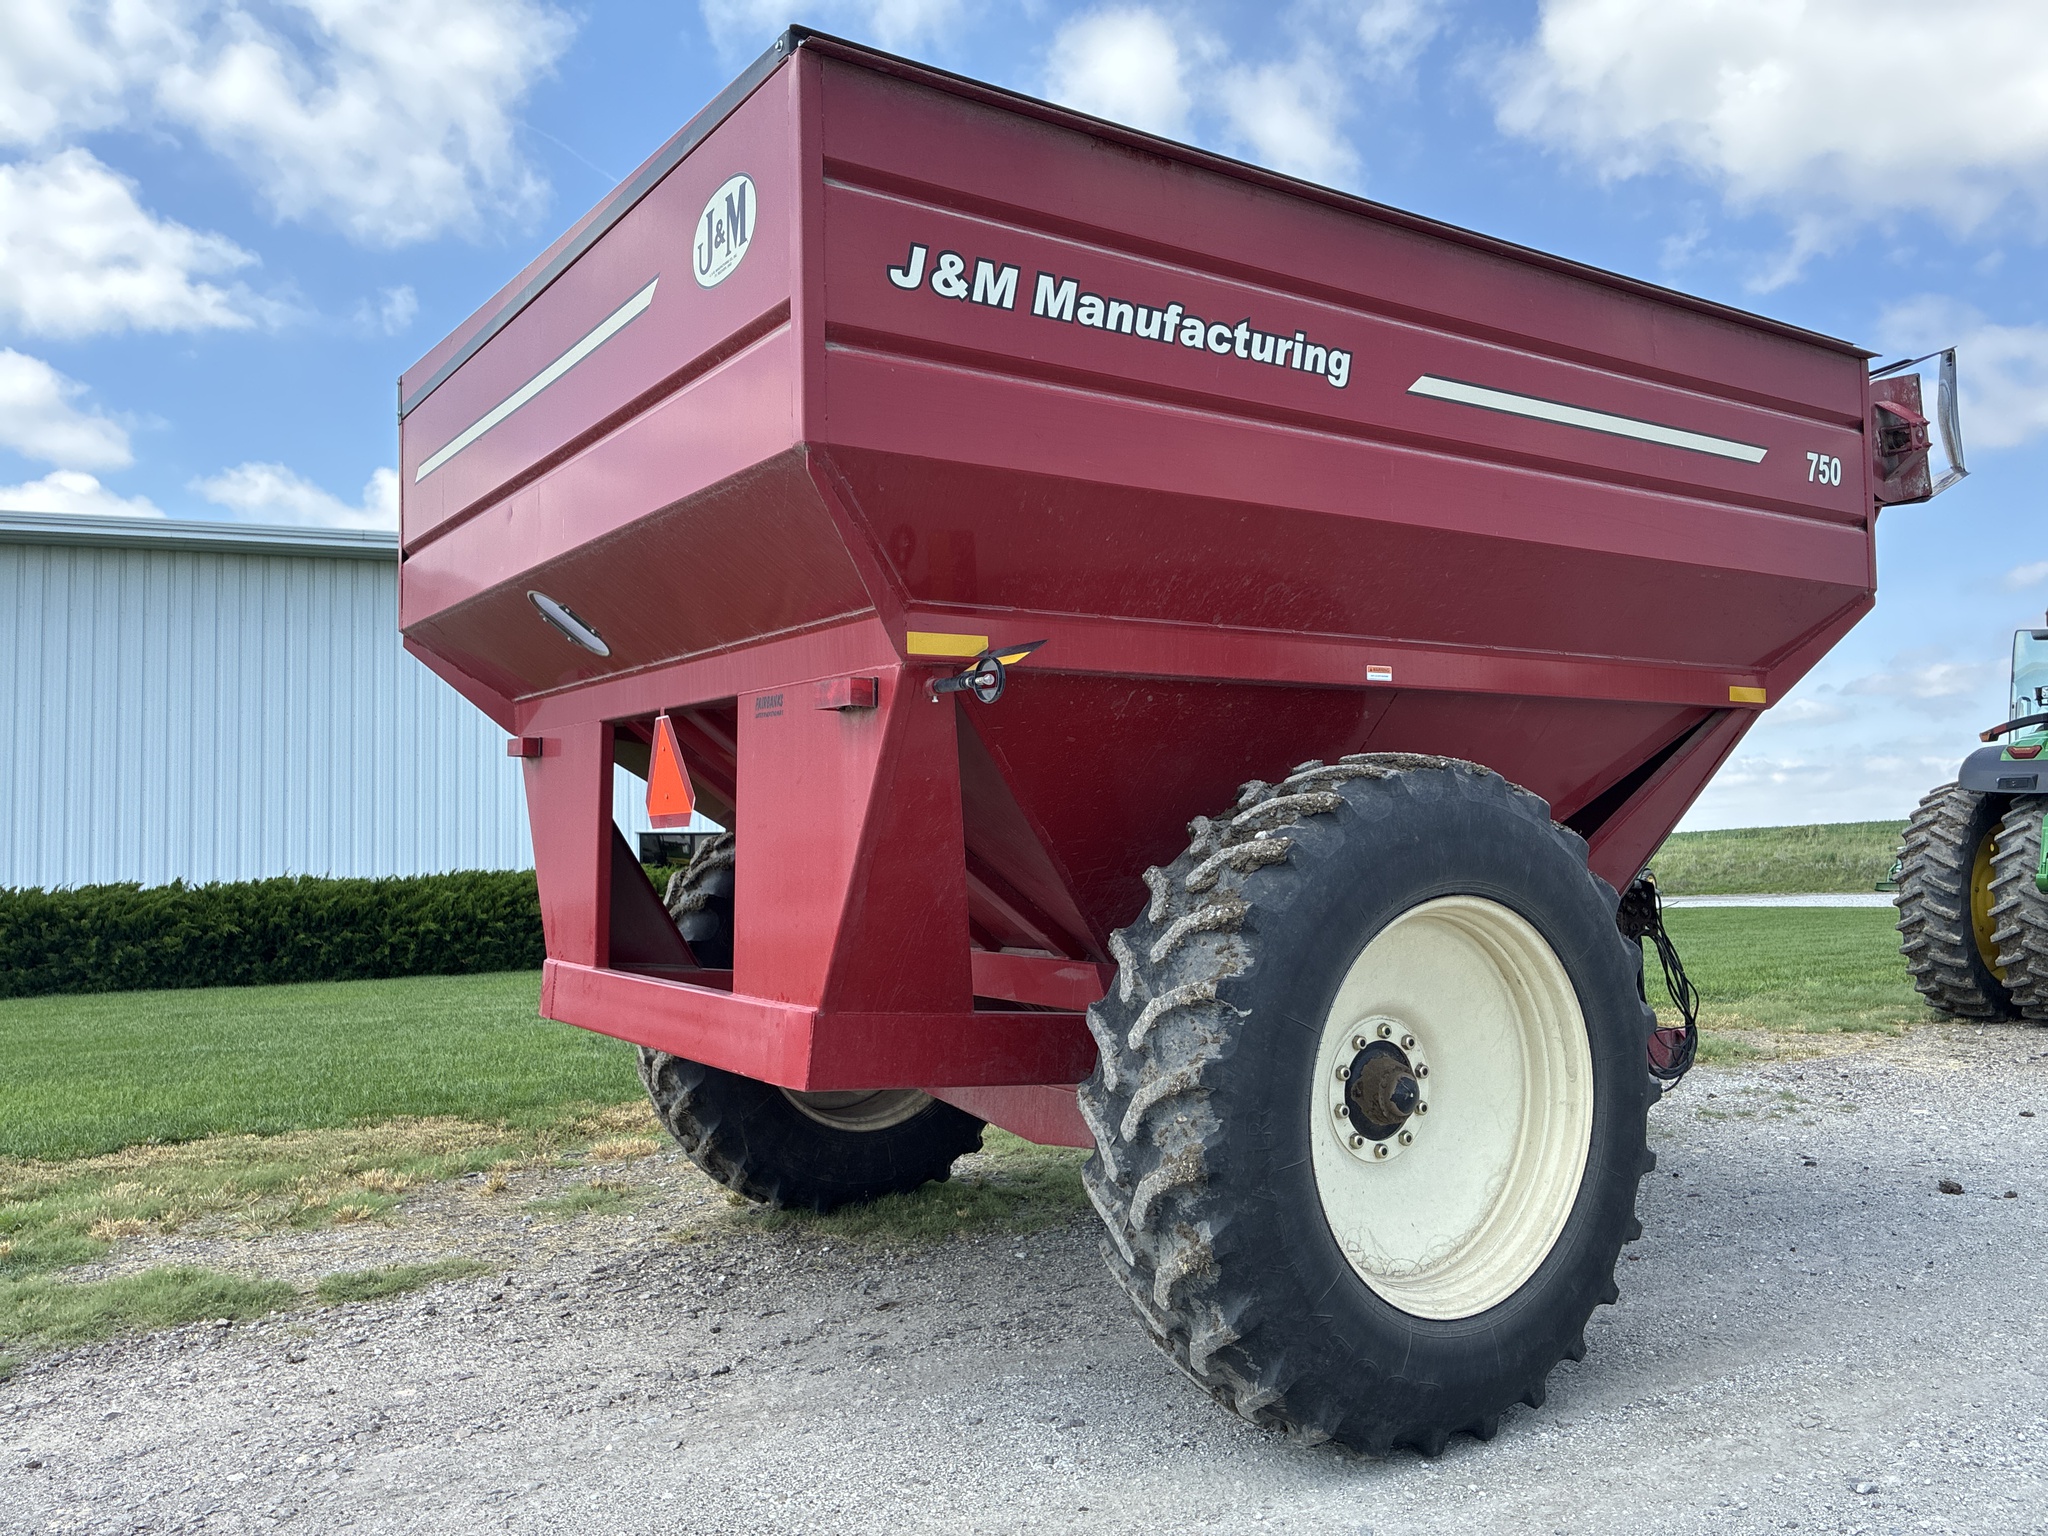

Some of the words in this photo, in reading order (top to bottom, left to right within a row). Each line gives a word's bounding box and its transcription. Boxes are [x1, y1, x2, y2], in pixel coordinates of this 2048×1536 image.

[697, 179, 748, 276] J&M
[888, 243, 1020, 310] J&M
[1031, 271, 1353, 389] Manufacturing
[1806, 451, 1842, 487] 750
